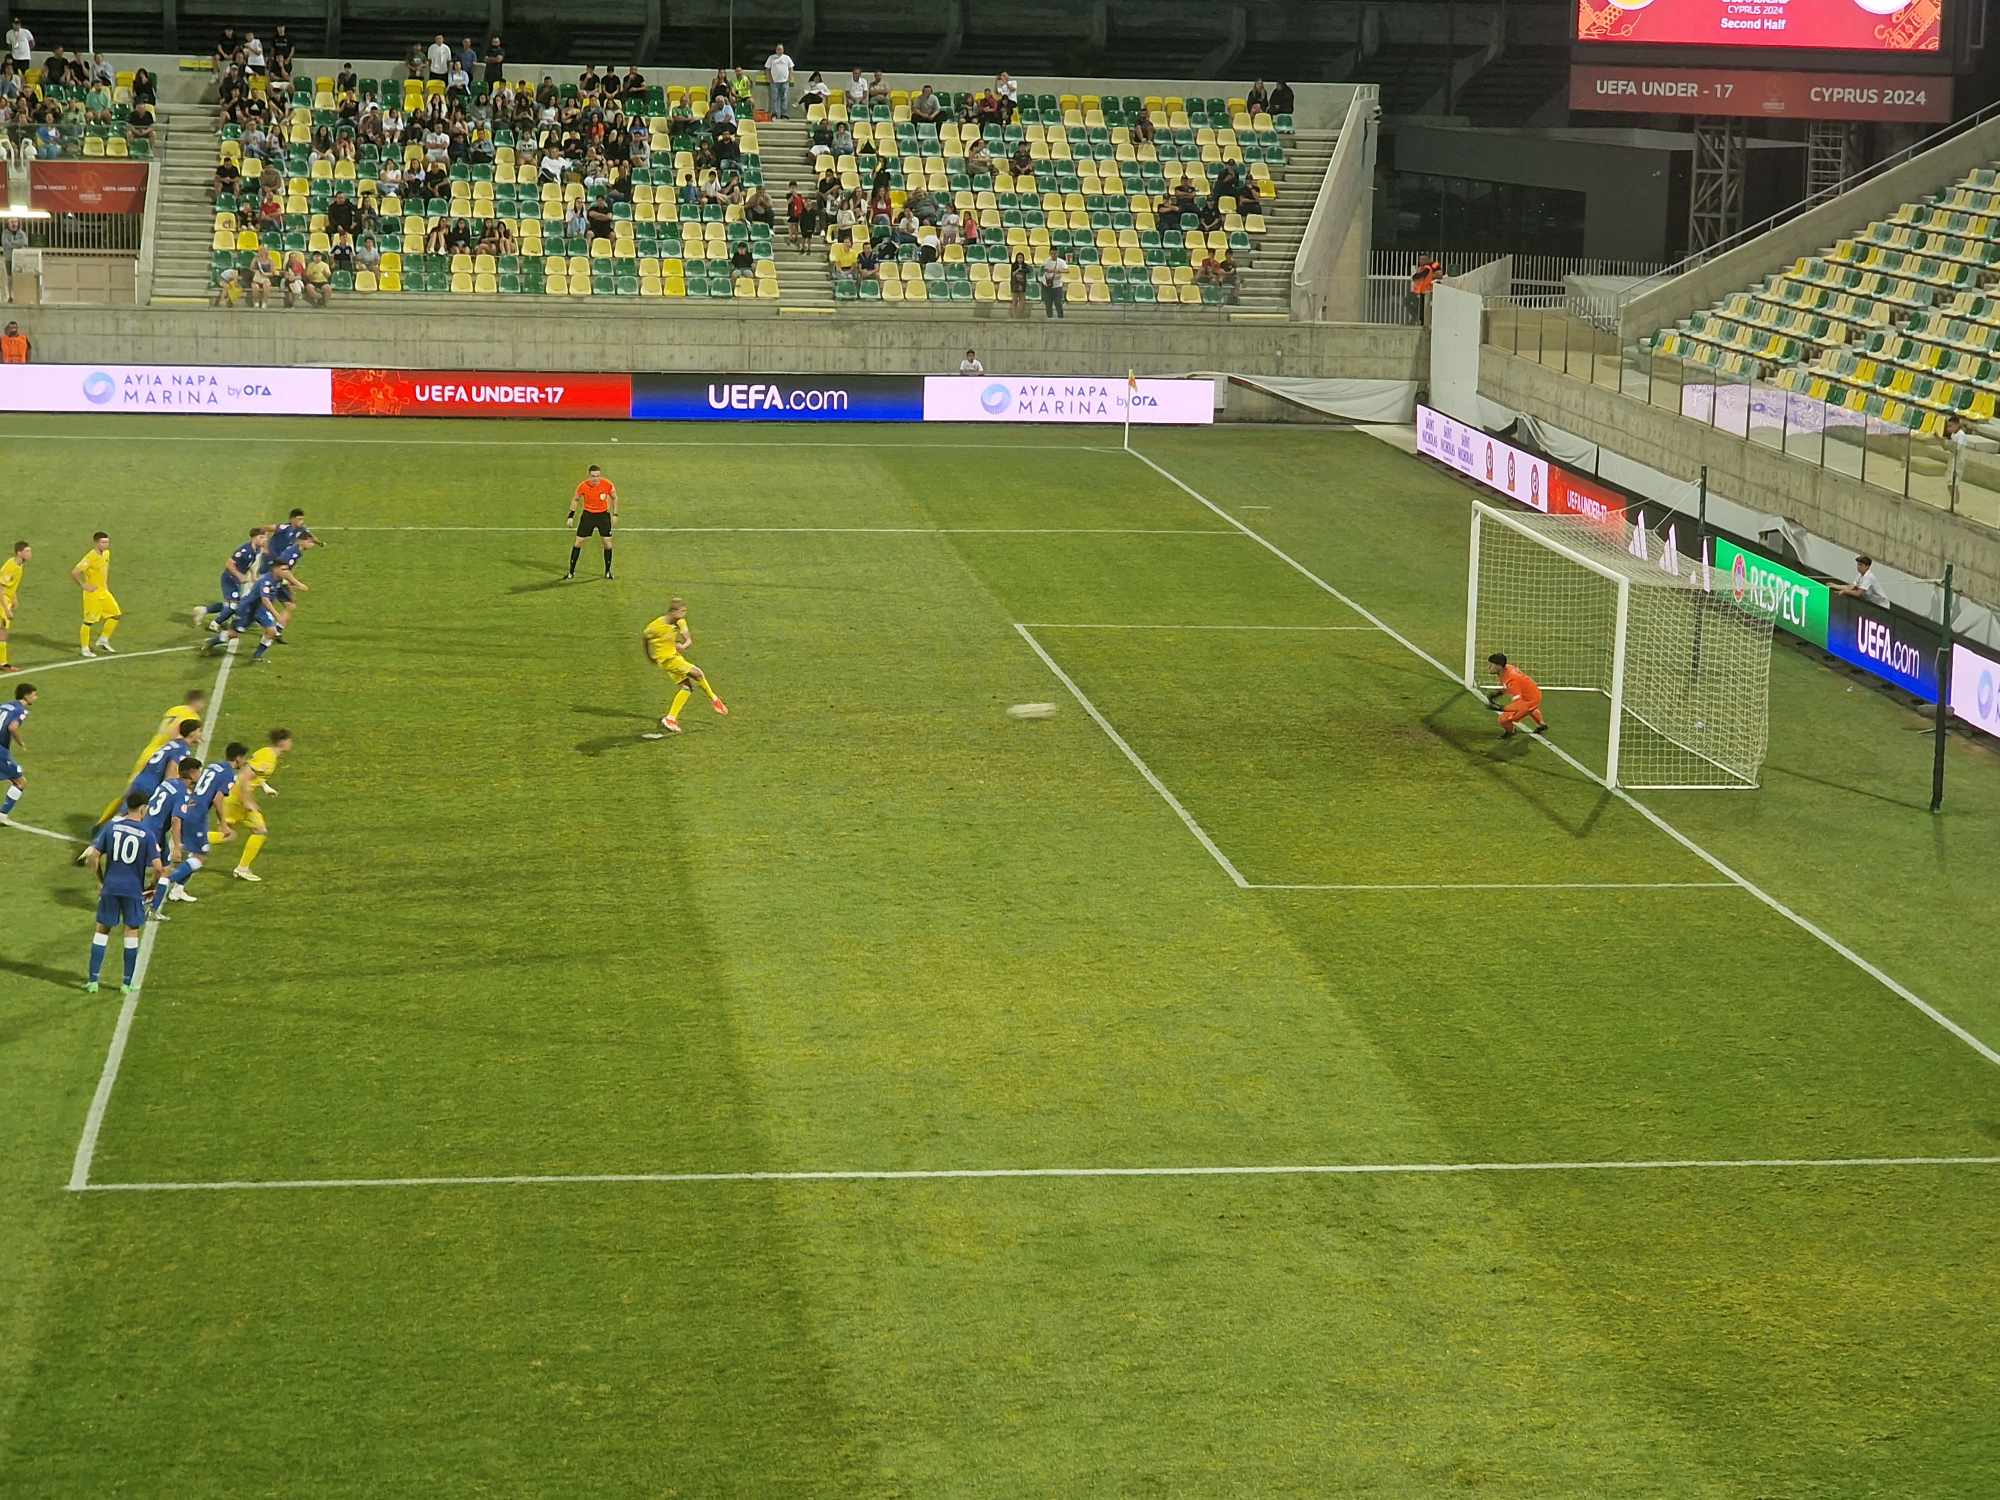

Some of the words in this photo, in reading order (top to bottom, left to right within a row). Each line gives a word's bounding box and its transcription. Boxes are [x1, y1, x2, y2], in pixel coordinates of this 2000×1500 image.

[1727, 5, 1761, 15] CYPRUS
[1763, 6, 1784, 15] 2024
[1720, 17, 1761, 29] Second
[1763, 18, 1786, 30] Half
[1596, 80, 1637, 96] UEFA
[1642, 82, 1698, 98] UNDER
[1713, 84, 1734, 99] 17
[1810, 87, 1878, 104] CYPRUS
[1883, 89, 1927, 106] 2024
[124, 375, 162, 386] AYIA
[172, 375, 219, 387] NAPA
[1020, 386, 1056, 397] AYIA
[1065, 386, 1108, 397] NAPA
[123, 390, 219, 405] MARINA
[227, 384, 241, 399] by
[415, 384, 469, 402] UEFA
[471, 385, 565, 404] UNDER-17
[708, 384, 848, 411] UEFA.com
[1018, 400, 1107, 415] MARINA
[1567, 489, 1582, 512] UEFA
[1749, 565, 1809, 627] RESPECT
[1857, 616, 1920, 680] UEFA.com
[113, 831, 139, 864] 10
